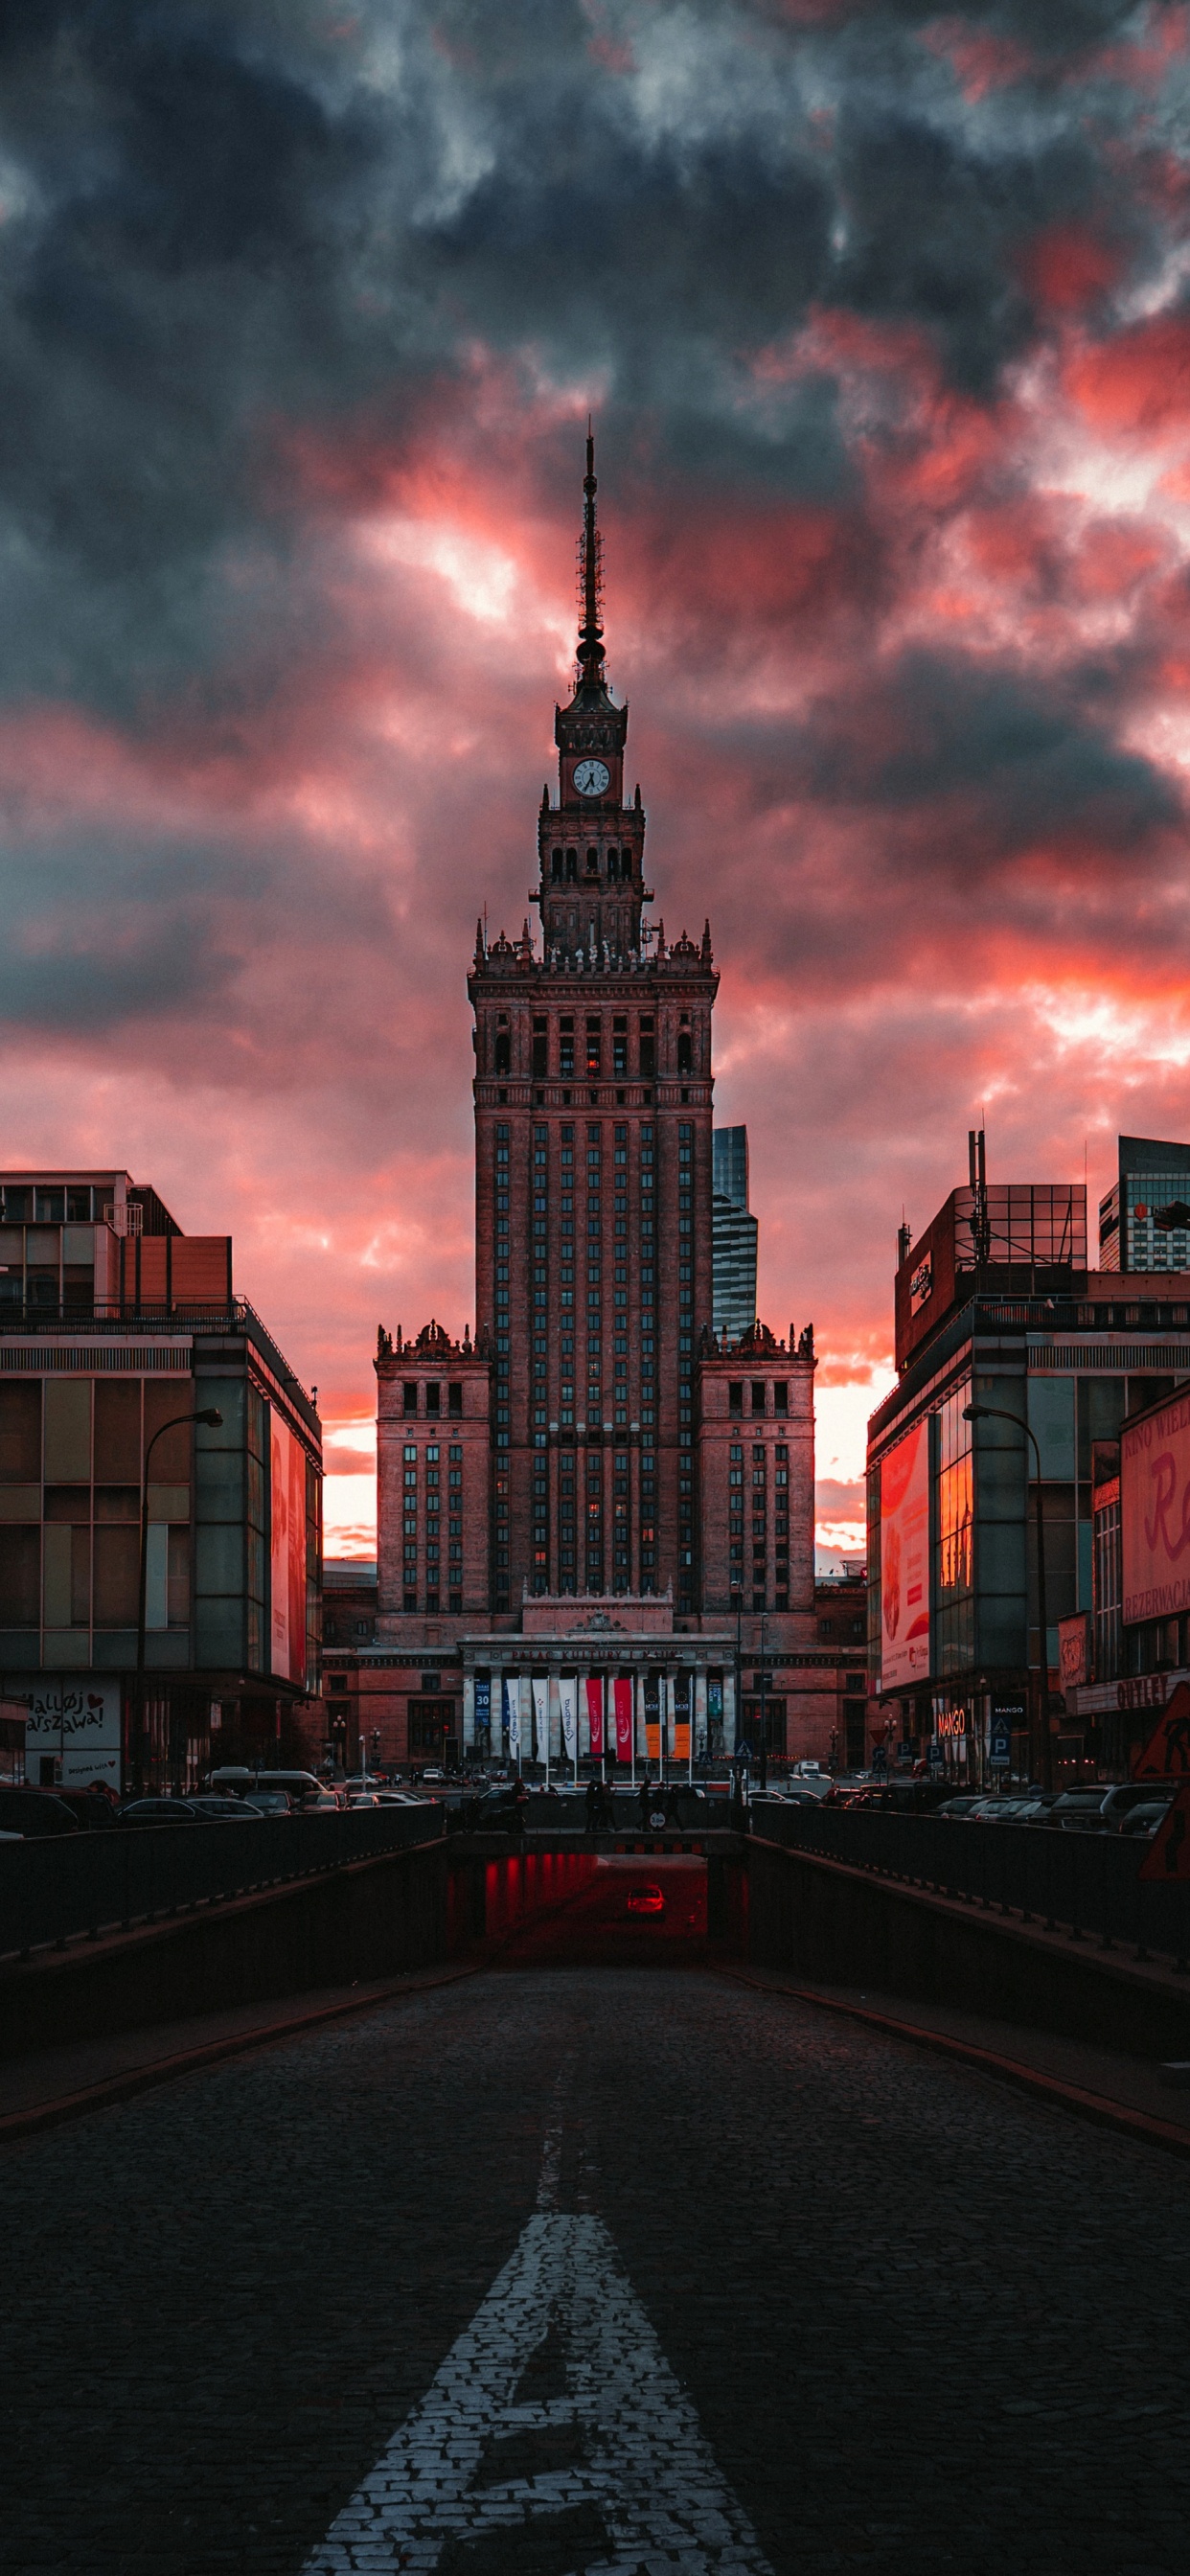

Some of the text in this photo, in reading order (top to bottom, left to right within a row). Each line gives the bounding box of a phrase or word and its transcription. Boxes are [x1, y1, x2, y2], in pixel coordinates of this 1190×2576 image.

[1124, 1422, 1153, 1459] KINO
[561, 1650, 622, 1660] KULTURY
[476, 1695, 490, 1705] 30
[1117, 1675, 1168, 1710] OUTLET
[27, 1707, 103, 1735] arszawa!
[938, 1709, 966, 1738] MANGO
[901, 1743, 909, 1755] P
[929, 1747, 939, 1760] P
[995, 1738, 1007, 1754] P
